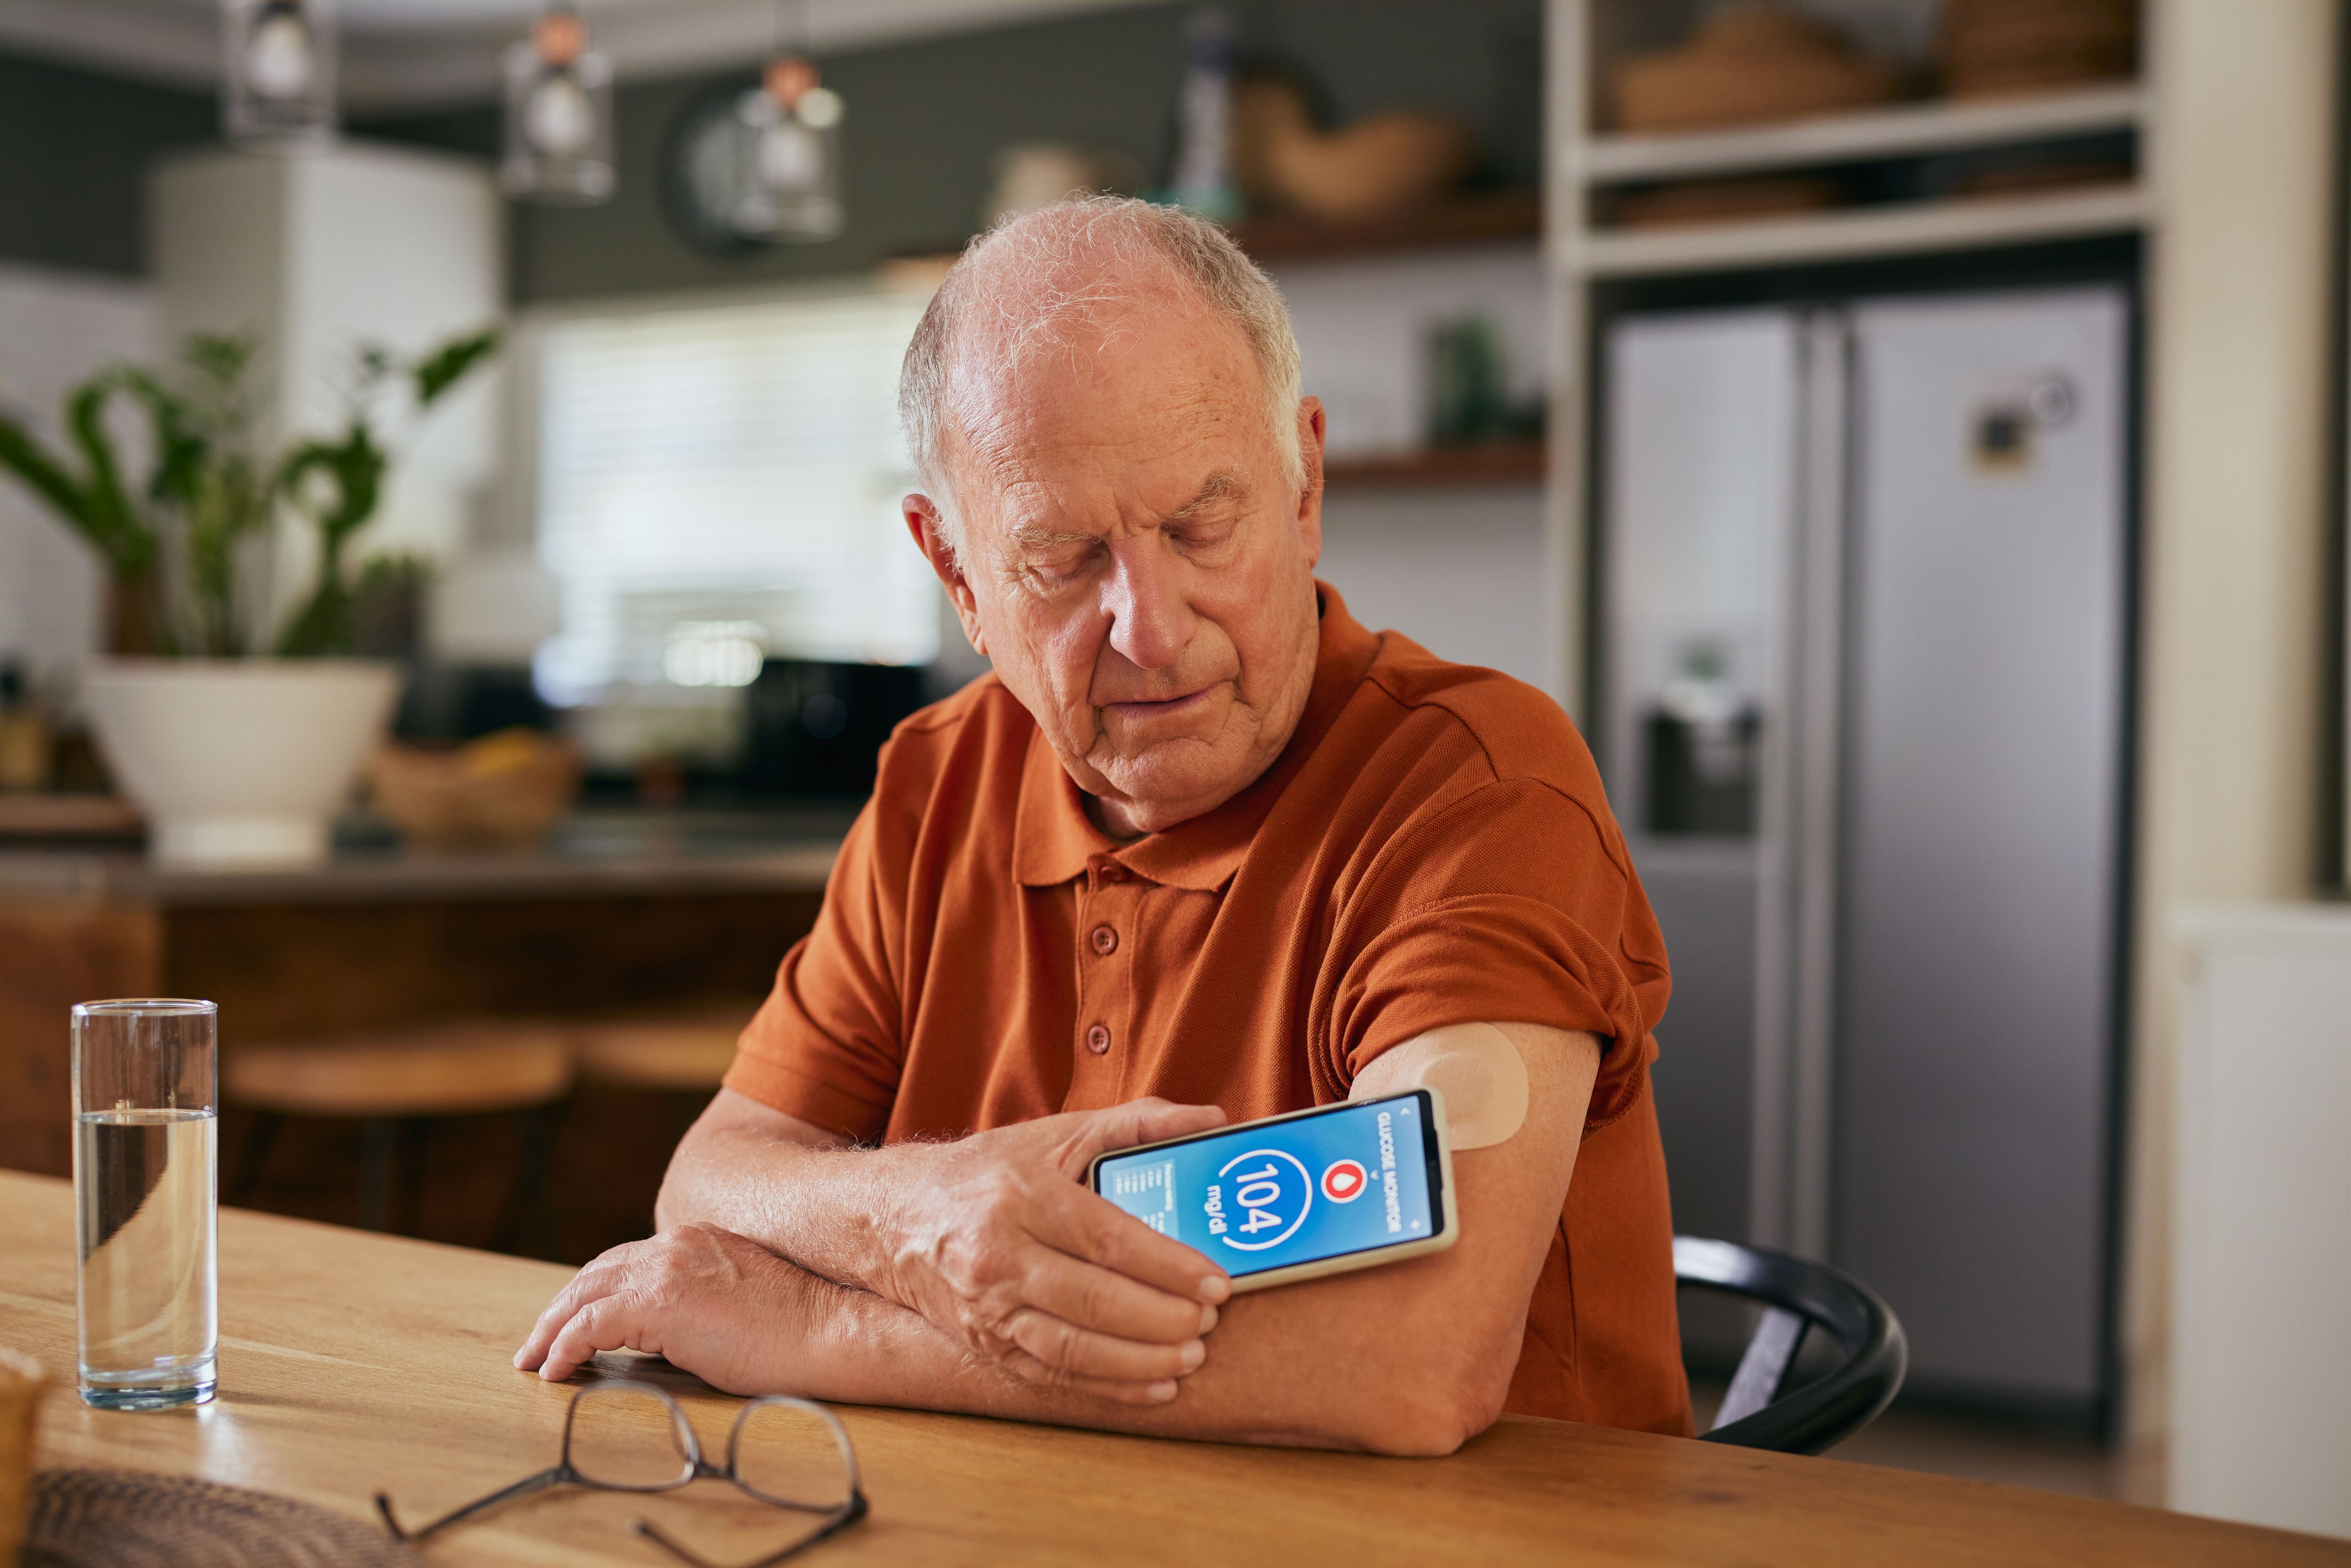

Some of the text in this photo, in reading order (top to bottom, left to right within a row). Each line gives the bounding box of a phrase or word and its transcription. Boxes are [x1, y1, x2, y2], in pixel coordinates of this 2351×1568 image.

[1236, 1163, 1282, 1234] 104
[1377, 1111, 1401, 1233] GLUCOSE MONITOR
[1204, 1185, 1227, 1234] mg/dl
